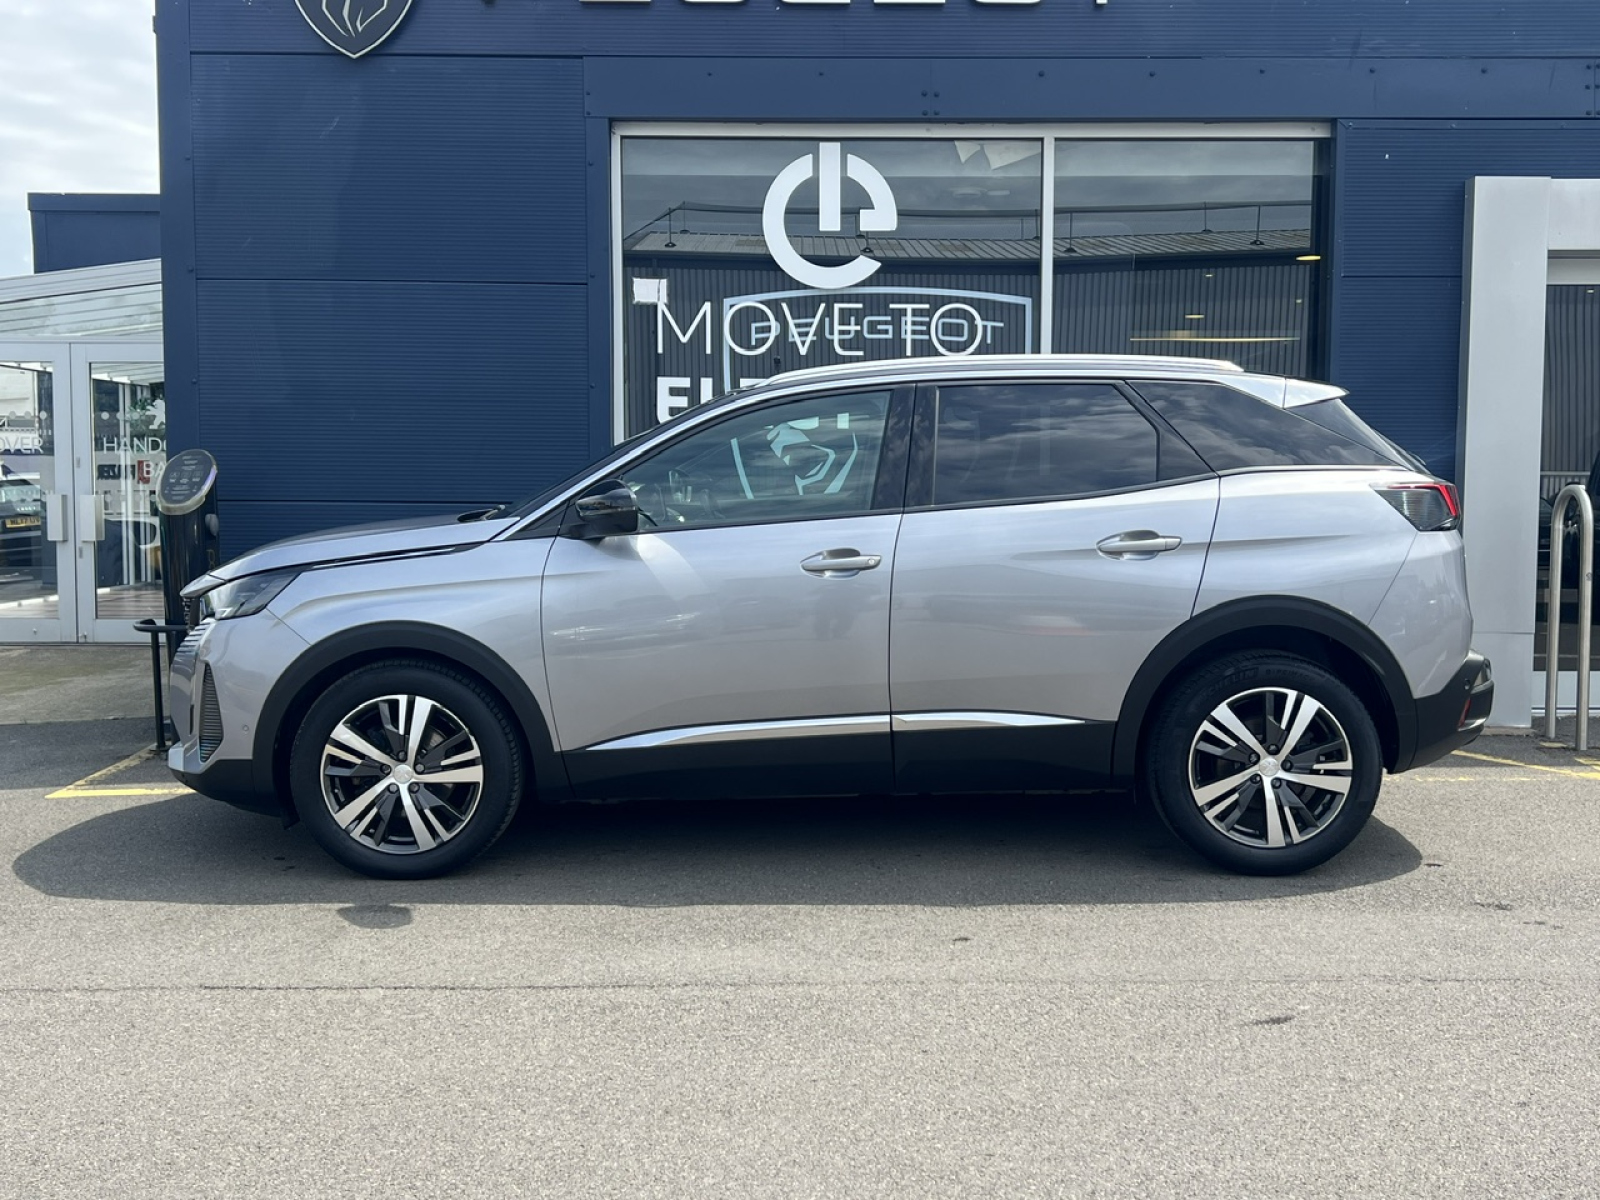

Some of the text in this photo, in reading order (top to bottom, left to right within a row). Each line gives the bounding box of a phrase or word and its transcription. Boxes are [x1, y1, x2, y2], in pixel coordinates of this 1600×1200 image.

[656, 301, 984, 357] MOVE TO
[750, 315, 1005, 346] PEUGEOT
[103, 437, 167, 454] HAND
